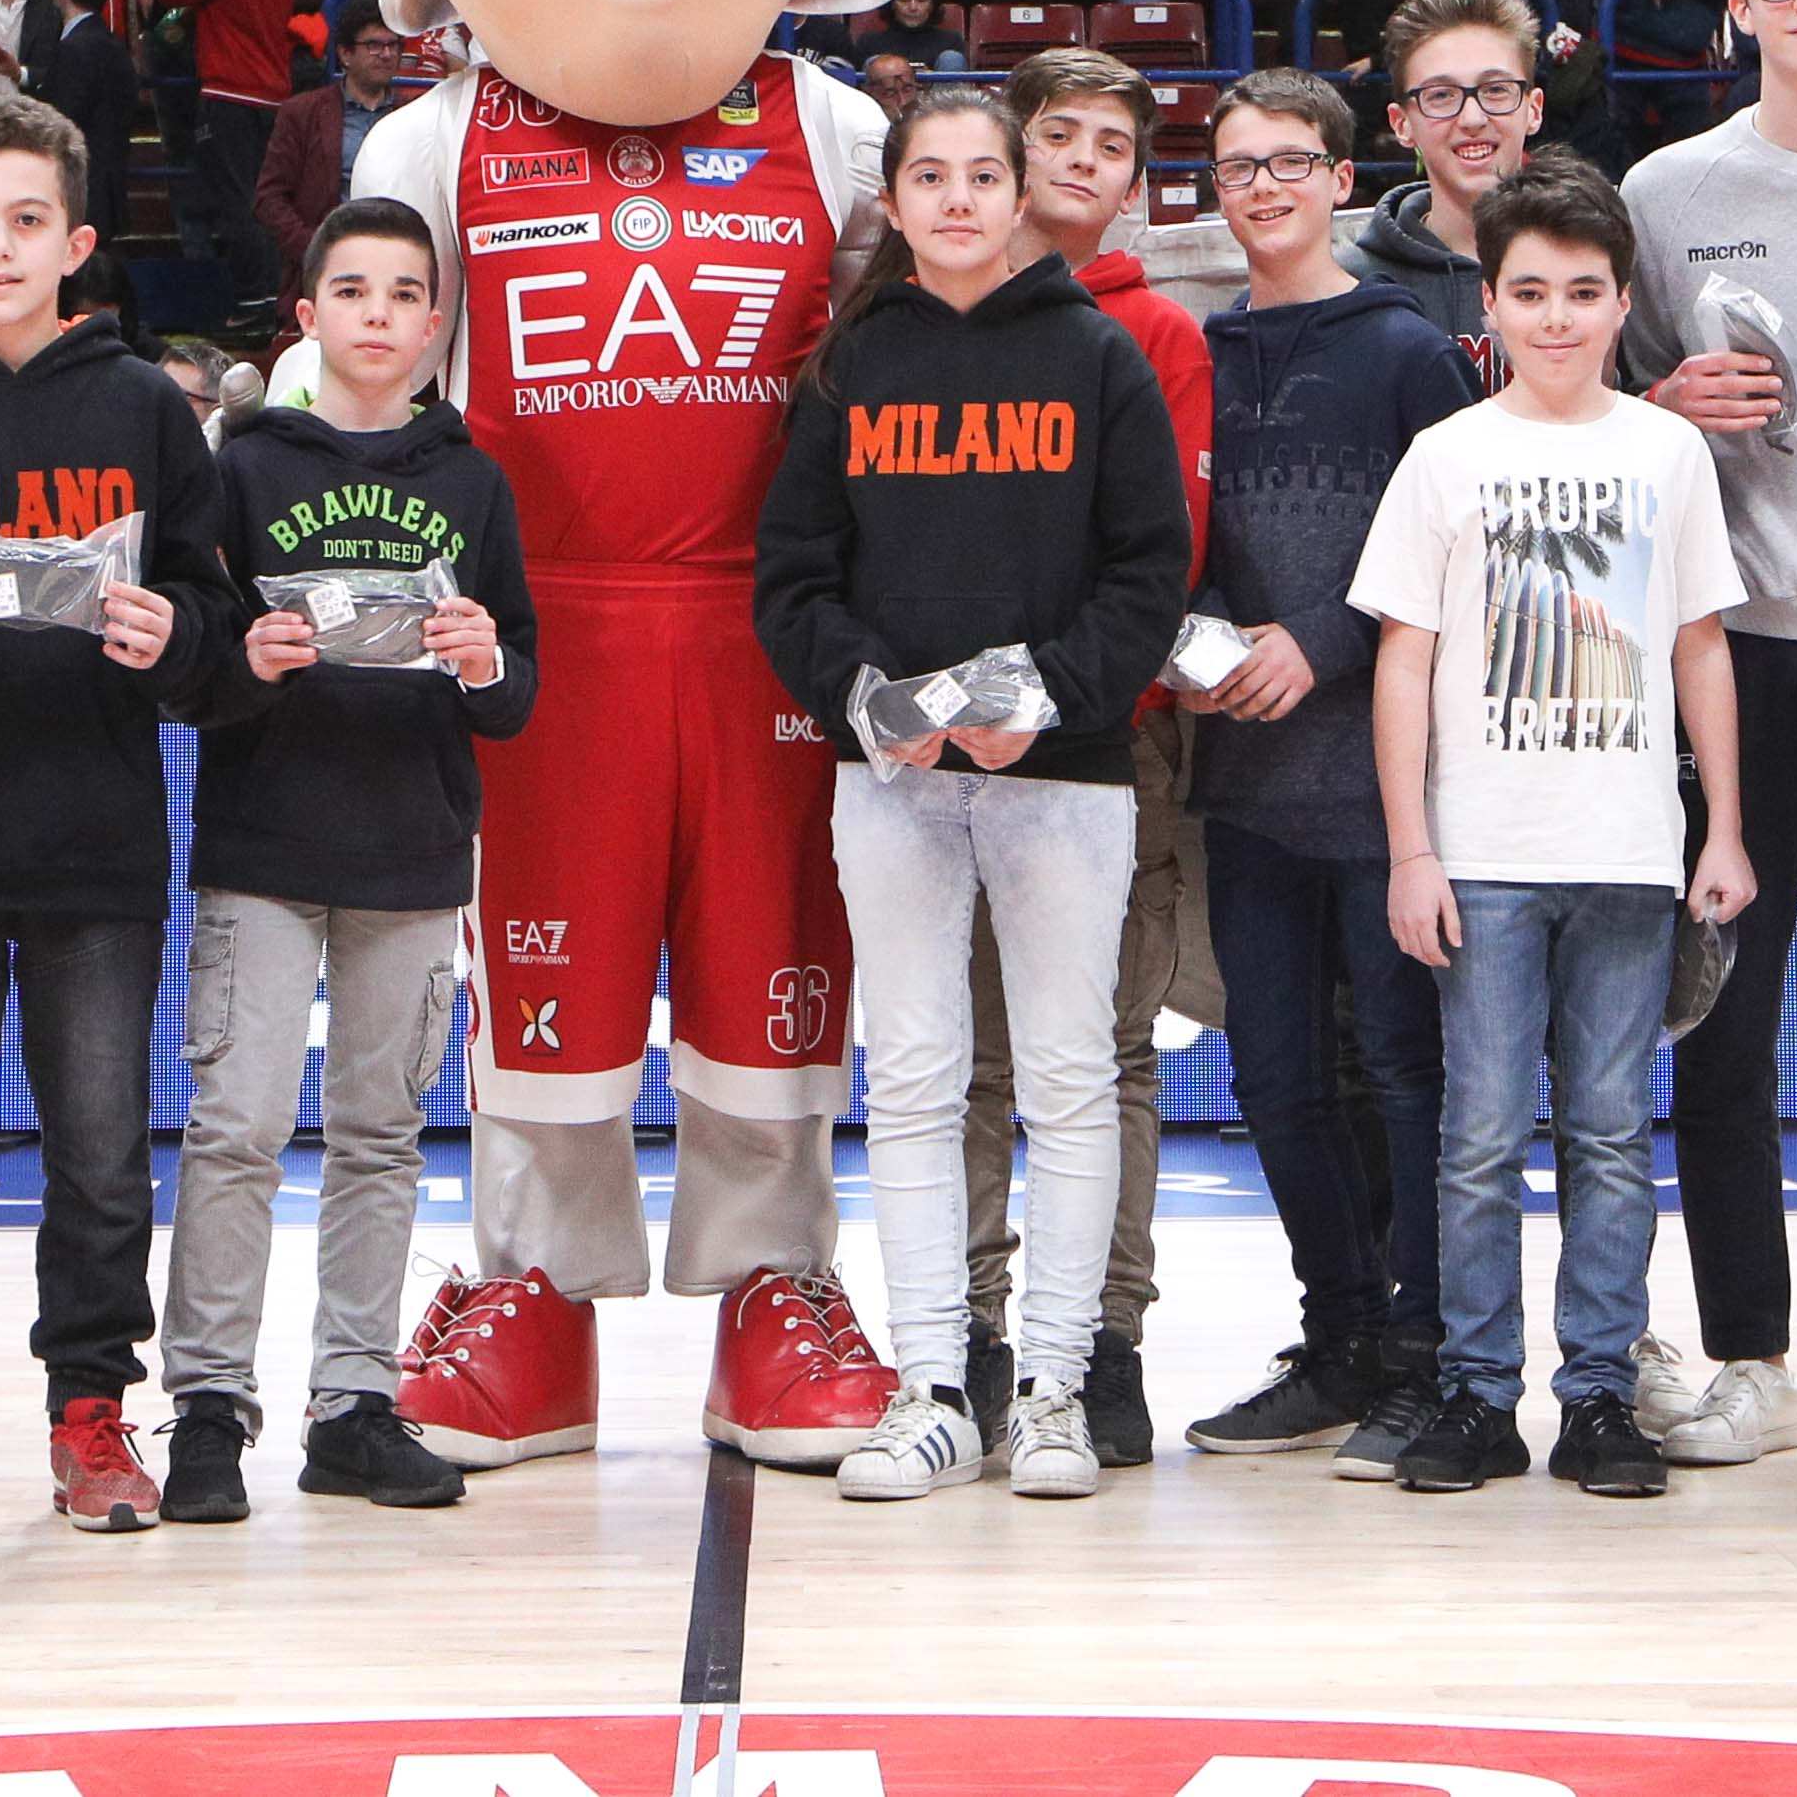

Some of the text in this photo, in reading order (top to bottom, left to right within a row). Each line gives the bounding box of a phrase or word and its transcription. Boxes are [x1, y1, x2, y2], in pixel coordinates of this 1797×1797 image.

[1022, 9, 1031, 21] 6
[1148, 9, 1156, 21] 7
[489, 156, 580, 186] UMANA
[685, 153, 749, 182] SAP
[1175, 189, 1184, 202] 7
[632, 217, 652, 231] FIP
[682, 209, 805, 246] LUXOTTICA
[1687, 242, 1767, 264] macron
[505, 263, 787, 380] EA7
[514, 375, 788, 416] EMPORIO ARMANI
[845, 402, 1075, 476] MILANO
[1481, 476, 1659, 537] TROPIC
[266, 484, 466, 566] BRAWLERS
[322, 538, 423, 565] DON'T NEED
[505, 920, 568, 954] EA7
[766, 964, 830, 1055] 36
